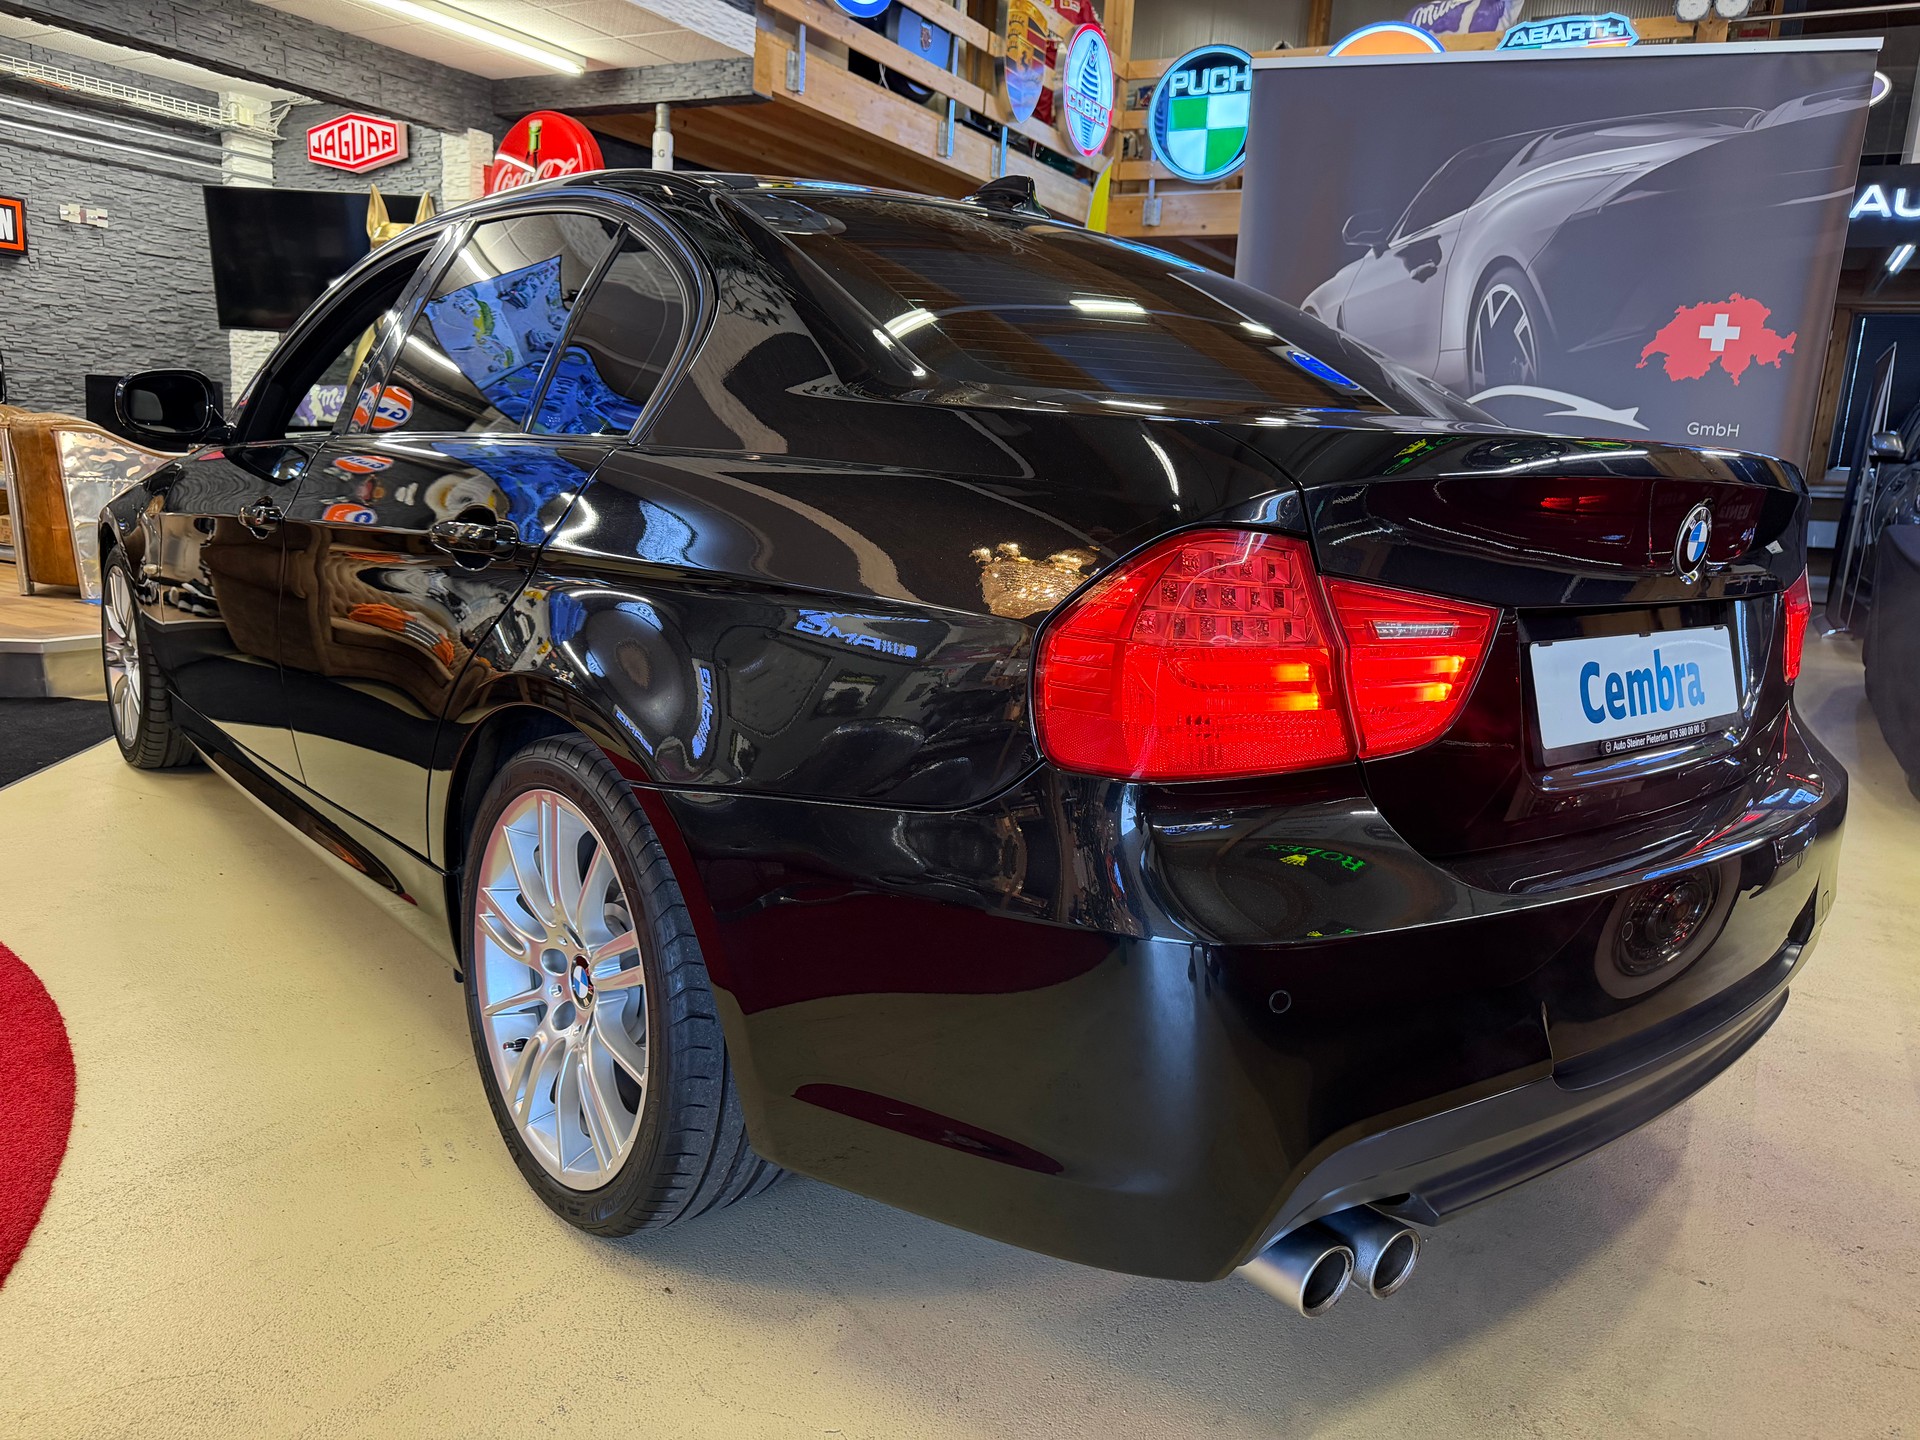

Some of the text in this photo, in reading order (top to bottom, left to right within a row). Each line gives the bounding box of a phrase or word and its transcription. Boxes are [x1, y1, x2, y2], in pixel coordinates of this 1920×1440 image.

[1507, 20, 1625, 46] ABARTH
[1168, 64, 1252, 97] PUCH
[1066, 92, 1108, 128] COBRA
[312, 121, 392, 162] JAGUAR
[1687, 421, 1740, 438] GmbH
[1579, 648, 1706, 725] Cembra
[1613, 740, 1626, 751] Auto
[1626, 737, 1646, 749] Steiner
[1669, 728, 1679, 740] 079
[1693, 724, 1700, 735] 90
